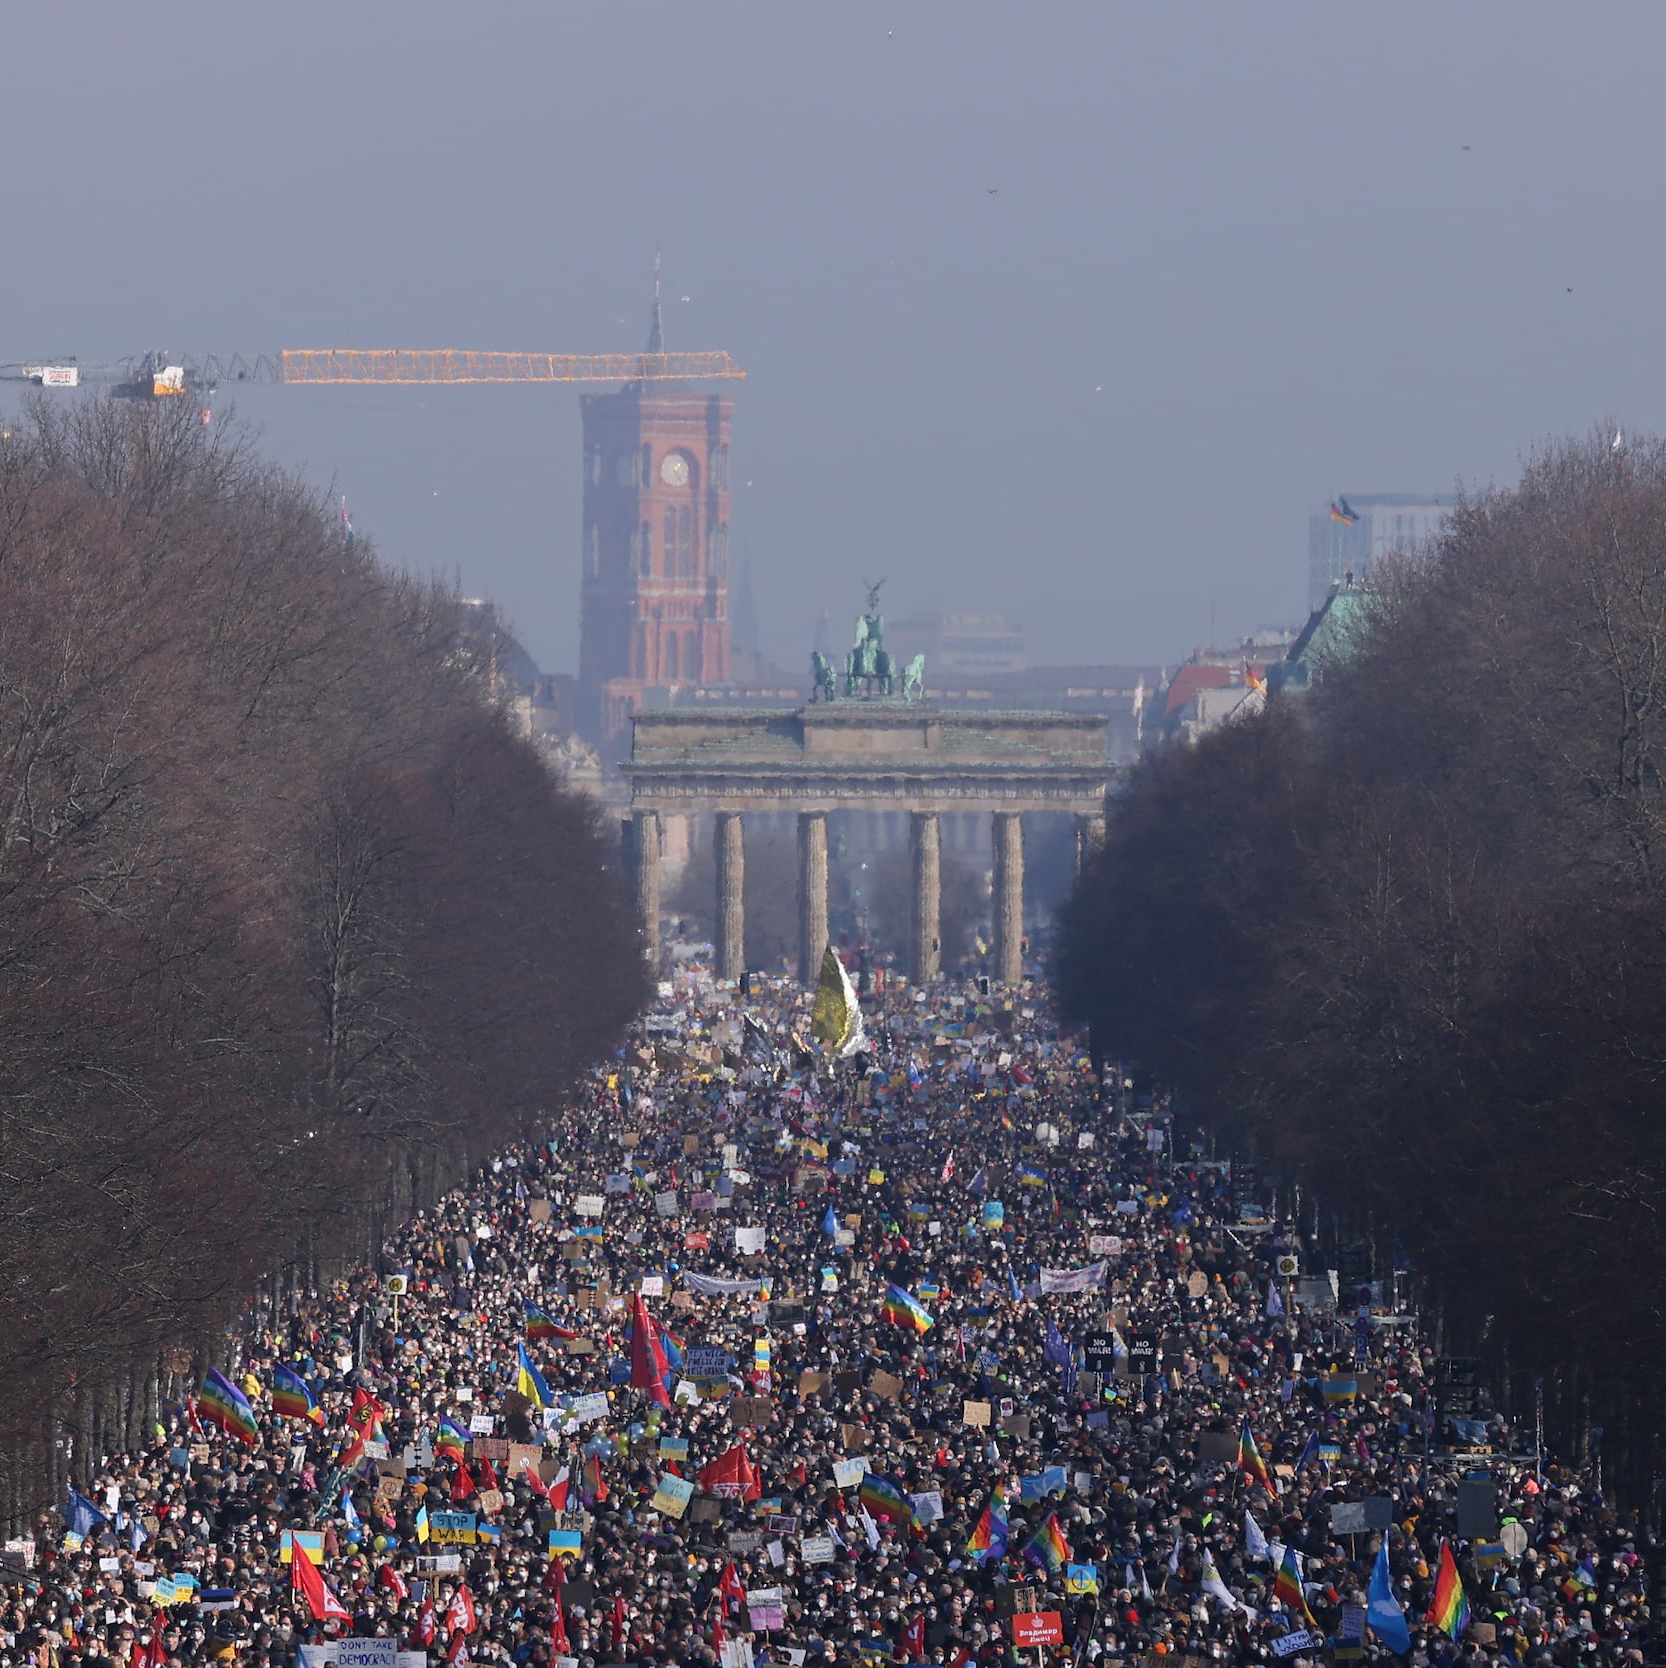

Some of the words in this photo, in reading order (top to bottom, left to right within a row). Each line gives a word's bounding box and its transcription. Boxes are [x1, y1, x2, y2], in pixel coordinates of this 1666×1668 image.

[1093, 1338, 1107, 1346] NO
[436, 1515, 468, 1527] STOP
[437, 1529, 464, 1540] WAR
[373, 1641, 393, 1650] TAKE
